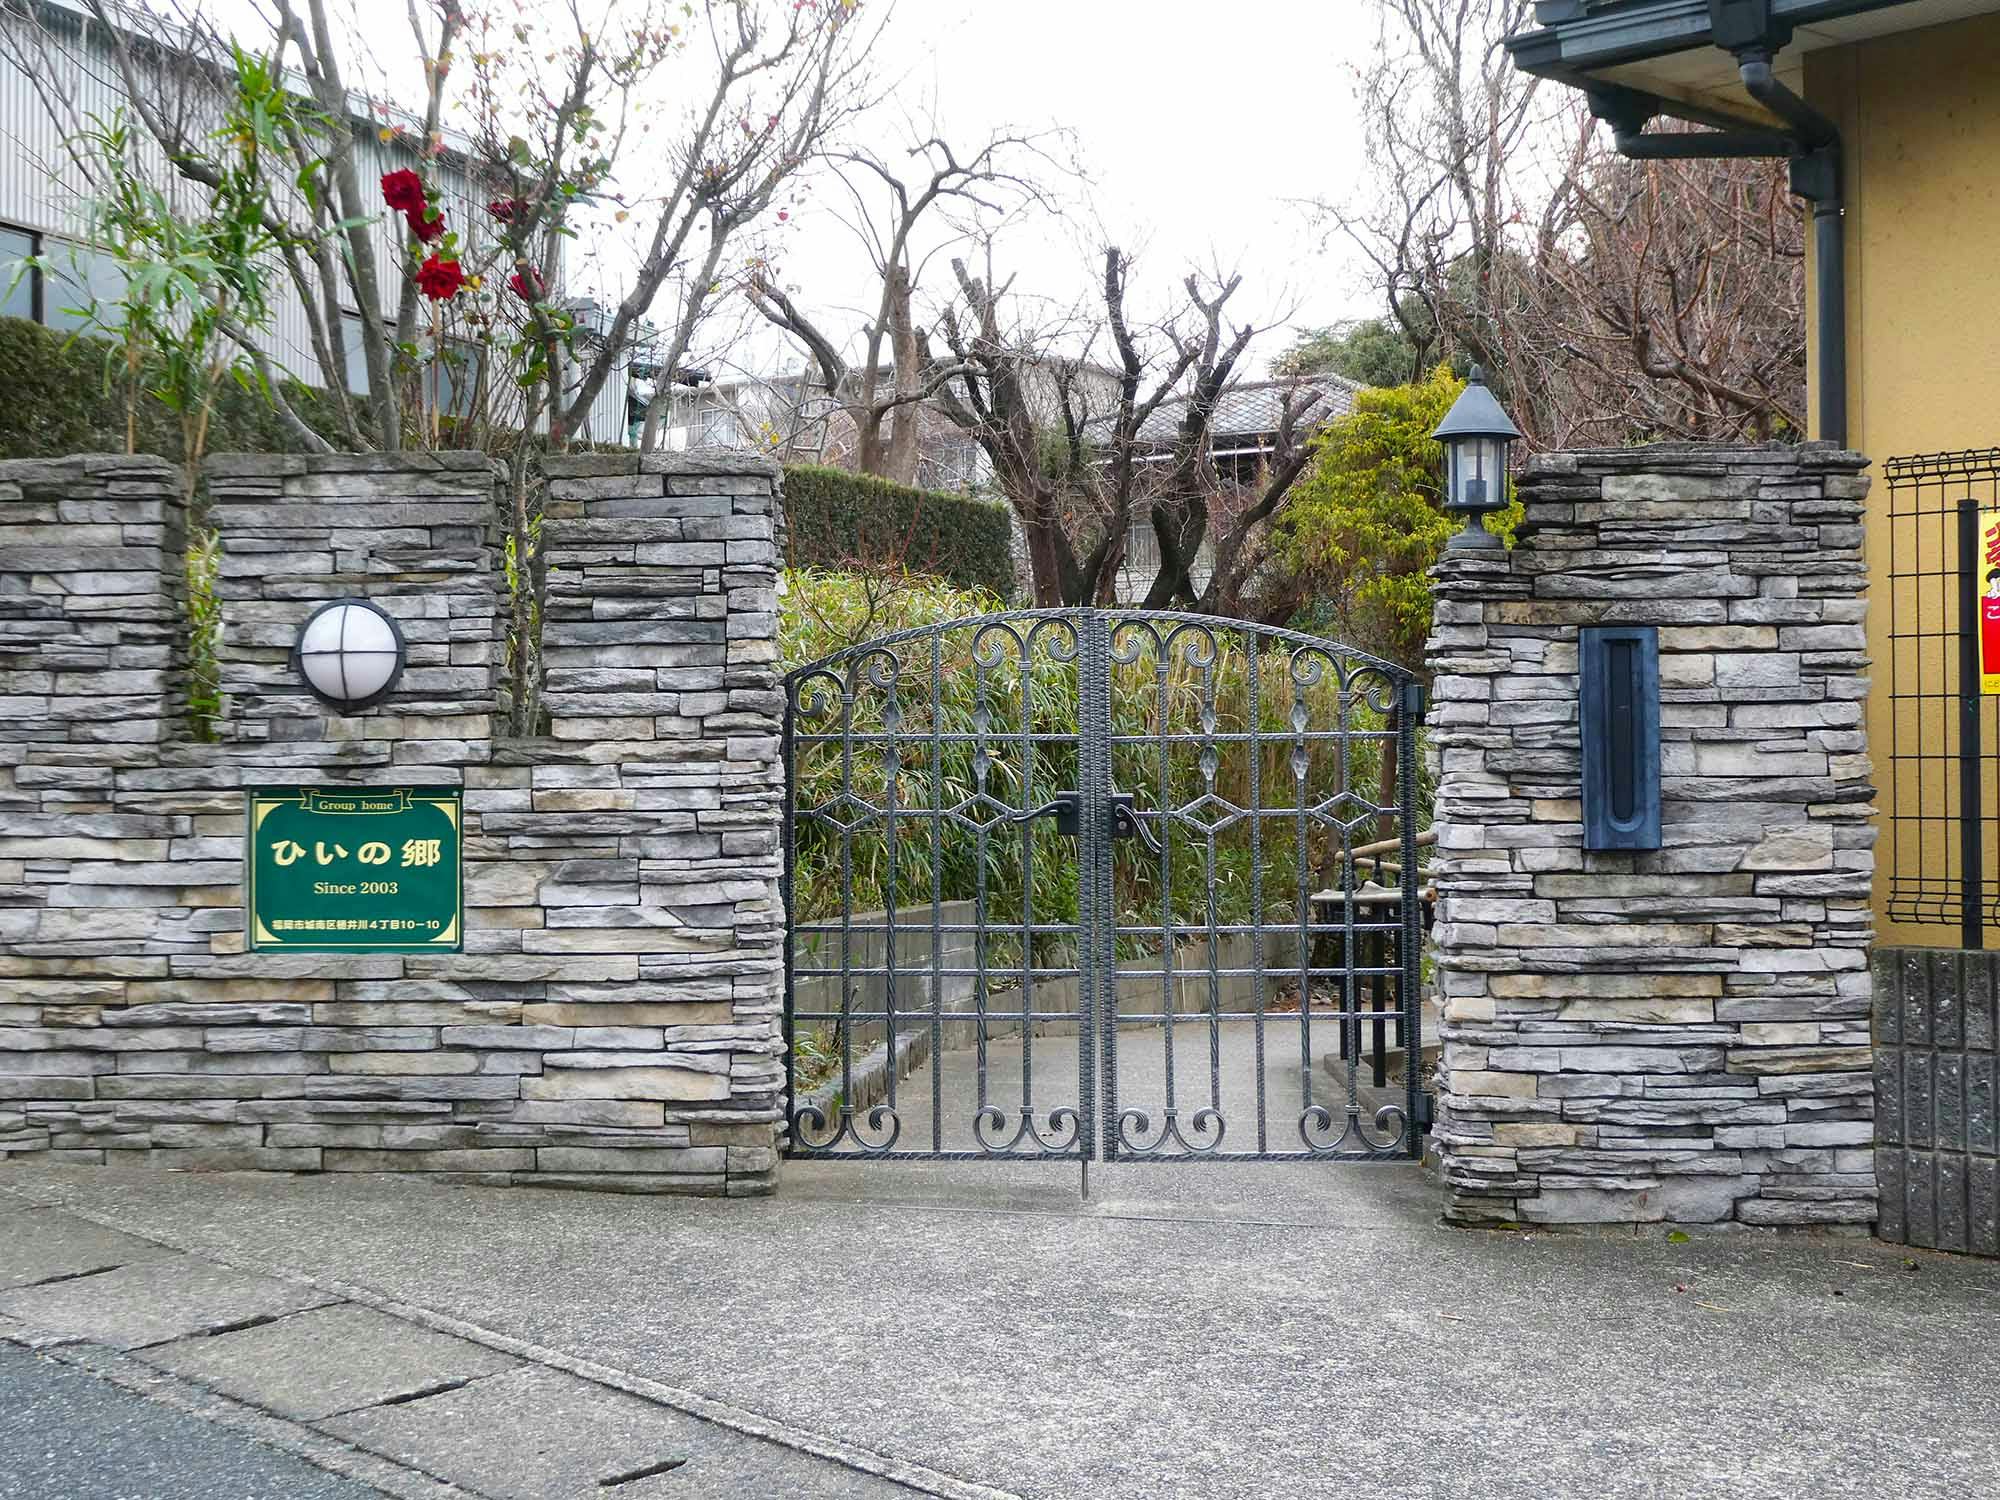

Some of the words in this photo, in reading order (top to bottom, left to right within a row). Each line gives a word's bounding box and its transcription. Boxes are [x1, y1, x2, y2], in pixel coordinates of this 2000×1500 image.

[319, 801, 356, 811] Group
[362, 801, 393, 810] home
[271, 839, 441, 867] ひいの郷
[314, 882, 356, 894] Since
[360, 882, 398, 894] 2003
